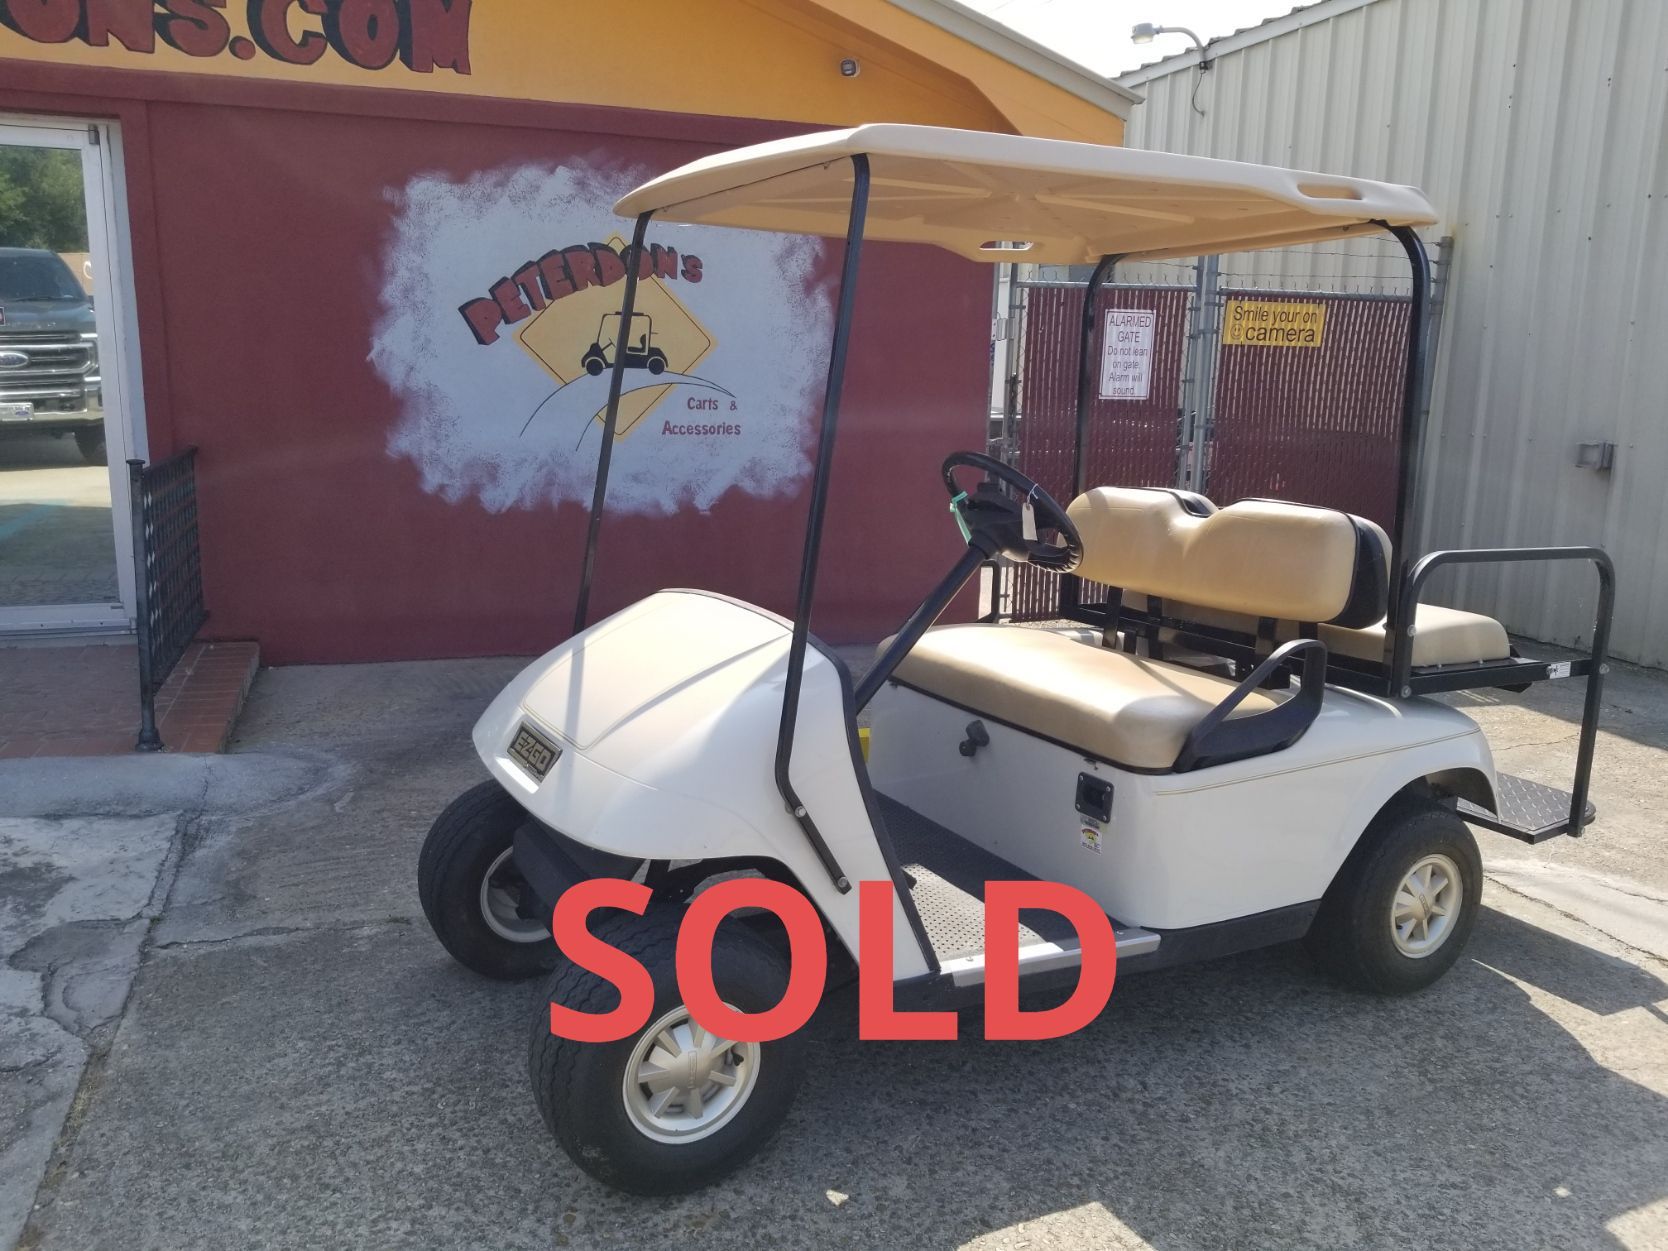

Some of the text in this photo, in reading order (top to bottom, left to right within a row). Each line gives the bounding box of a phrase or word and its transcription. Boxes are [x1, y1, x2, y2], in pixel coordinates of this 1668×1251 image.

[1109, 315, 1151, 327] ALARMED
[1233, 305, 1317, 326] Smile your on
[1117, 331, 1141, 343] GATE
[1246, 326, 1315, 343] camera
[1107, 346, 1149, 356] Do not lean
[1113, 361, 1121, 369] on
[1108, 372, 1143, 382] Alarm will
[687, 397, 738, 411] Carts &
[661, 420, 741, 436] Accessories
